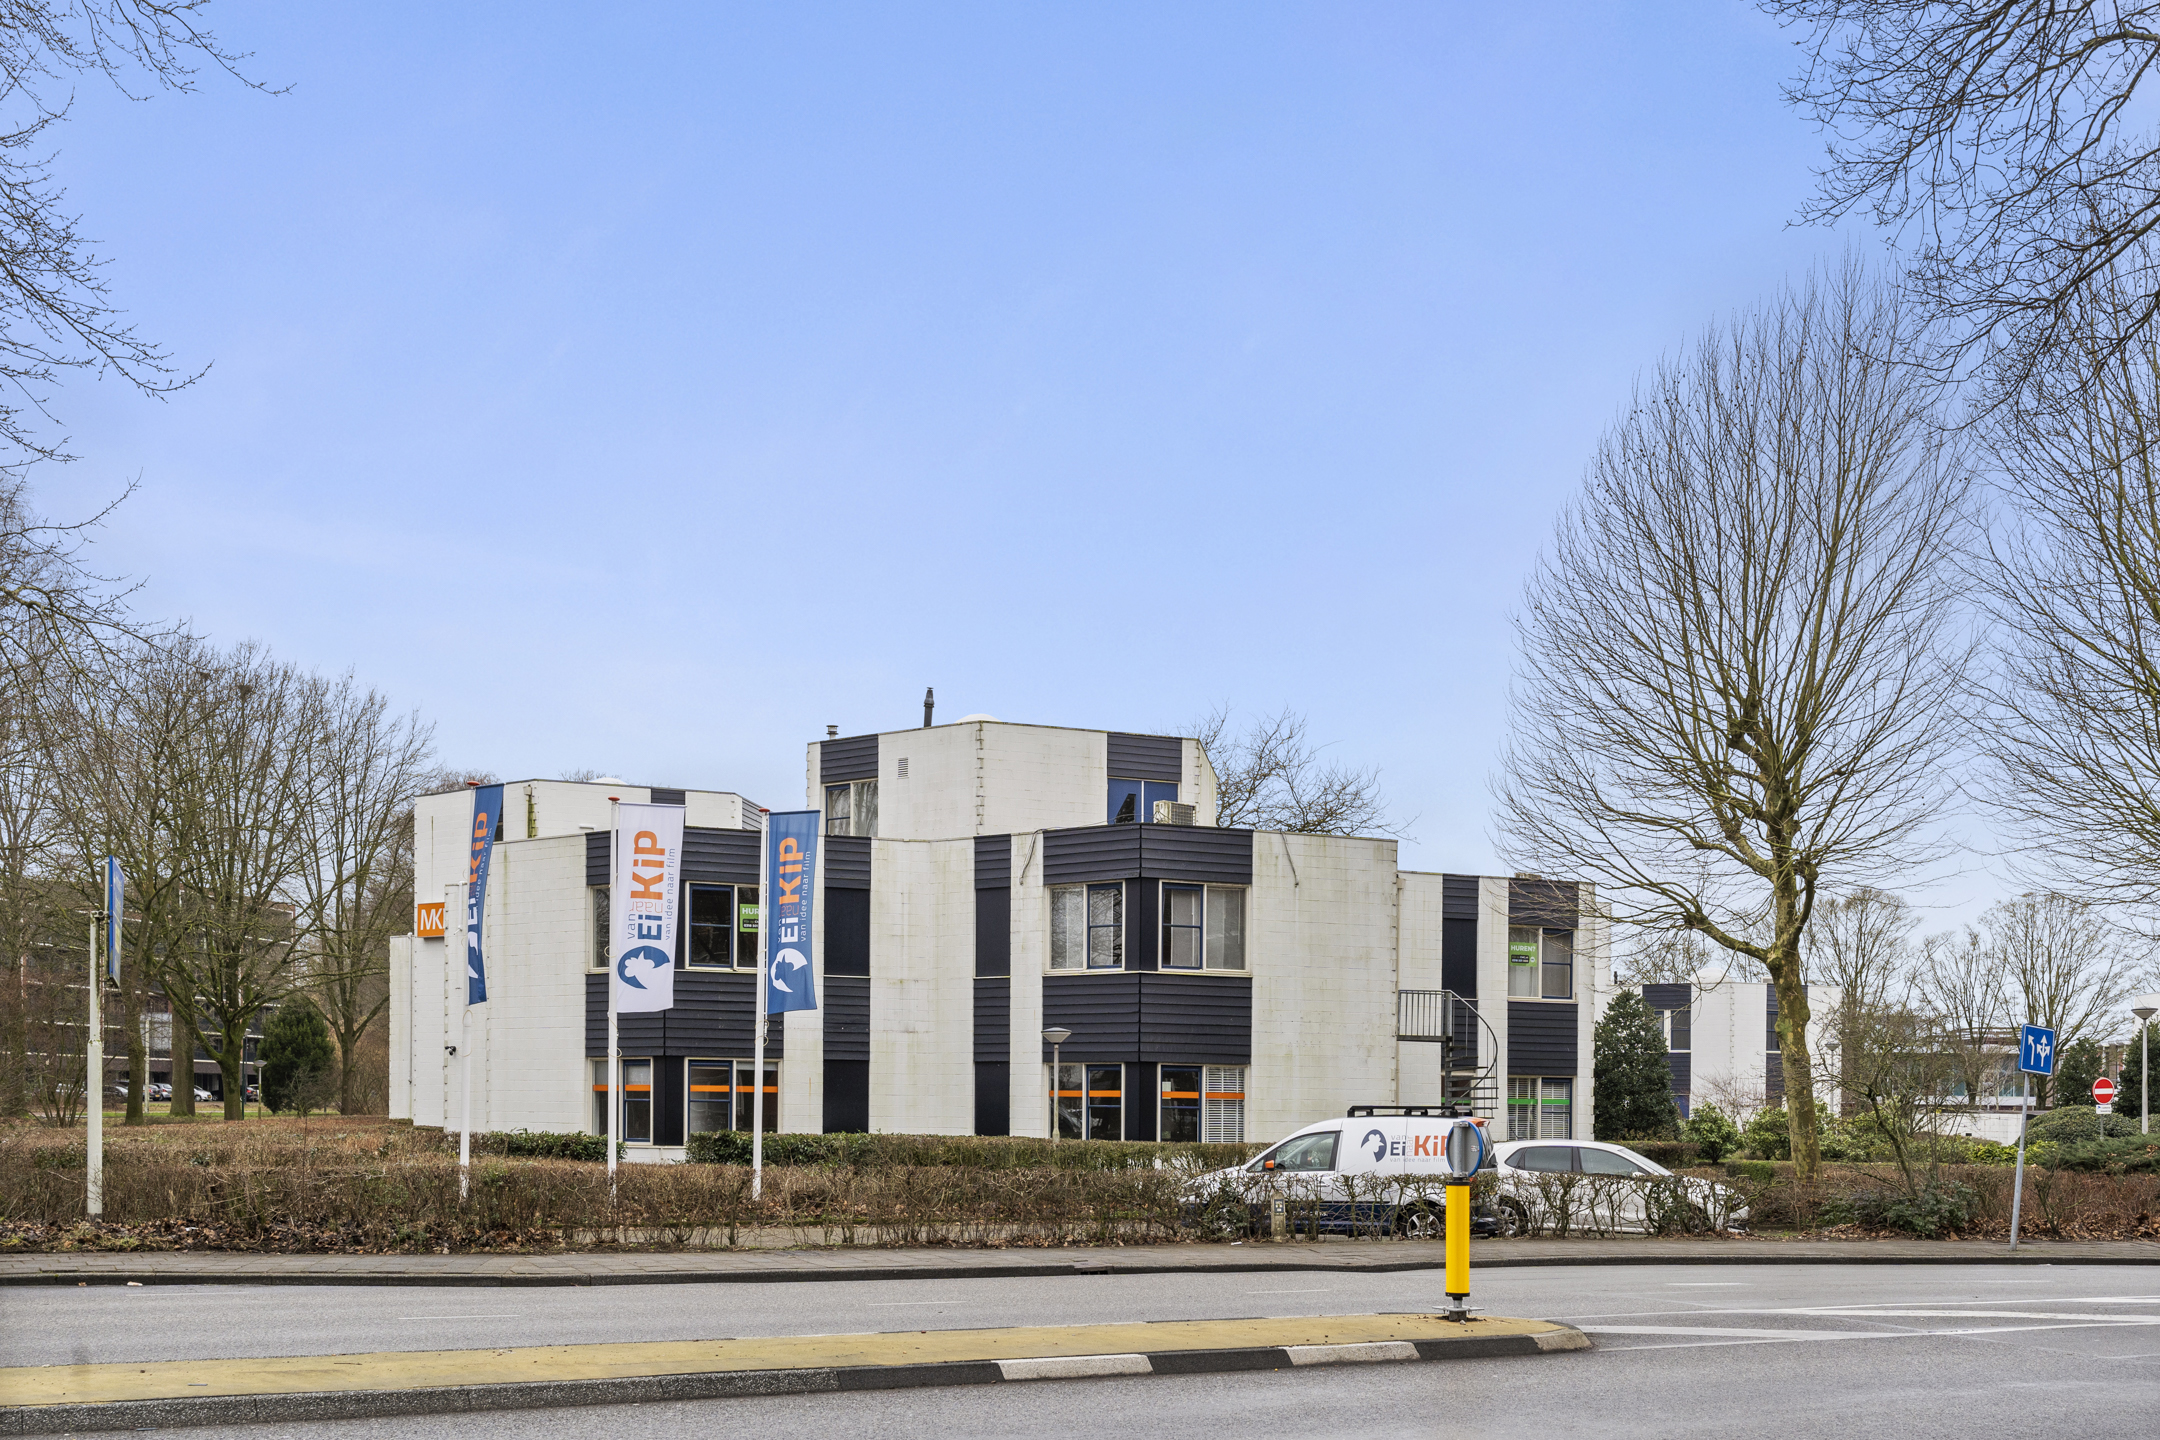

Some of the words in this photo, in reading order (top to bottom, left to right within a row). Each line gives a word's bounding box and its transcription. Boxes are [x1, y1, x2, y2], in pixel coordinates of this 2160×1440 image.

[666, 848, 676, 868] film
[802, 851, 811, 871] film
[667, 871, 675, 895] naar
[801, 874, 809, 896] naar
[420, 908, 445, 931] MK
[664, 898, 674, 920] idee
[799, 899, 808, 921] idee
[627, 913, 636, 940] van
[637, 914, 663, 941] Ei
[780, 917, 799, 943] Ei
[1390, 1141, 1405, 1156] Ei
